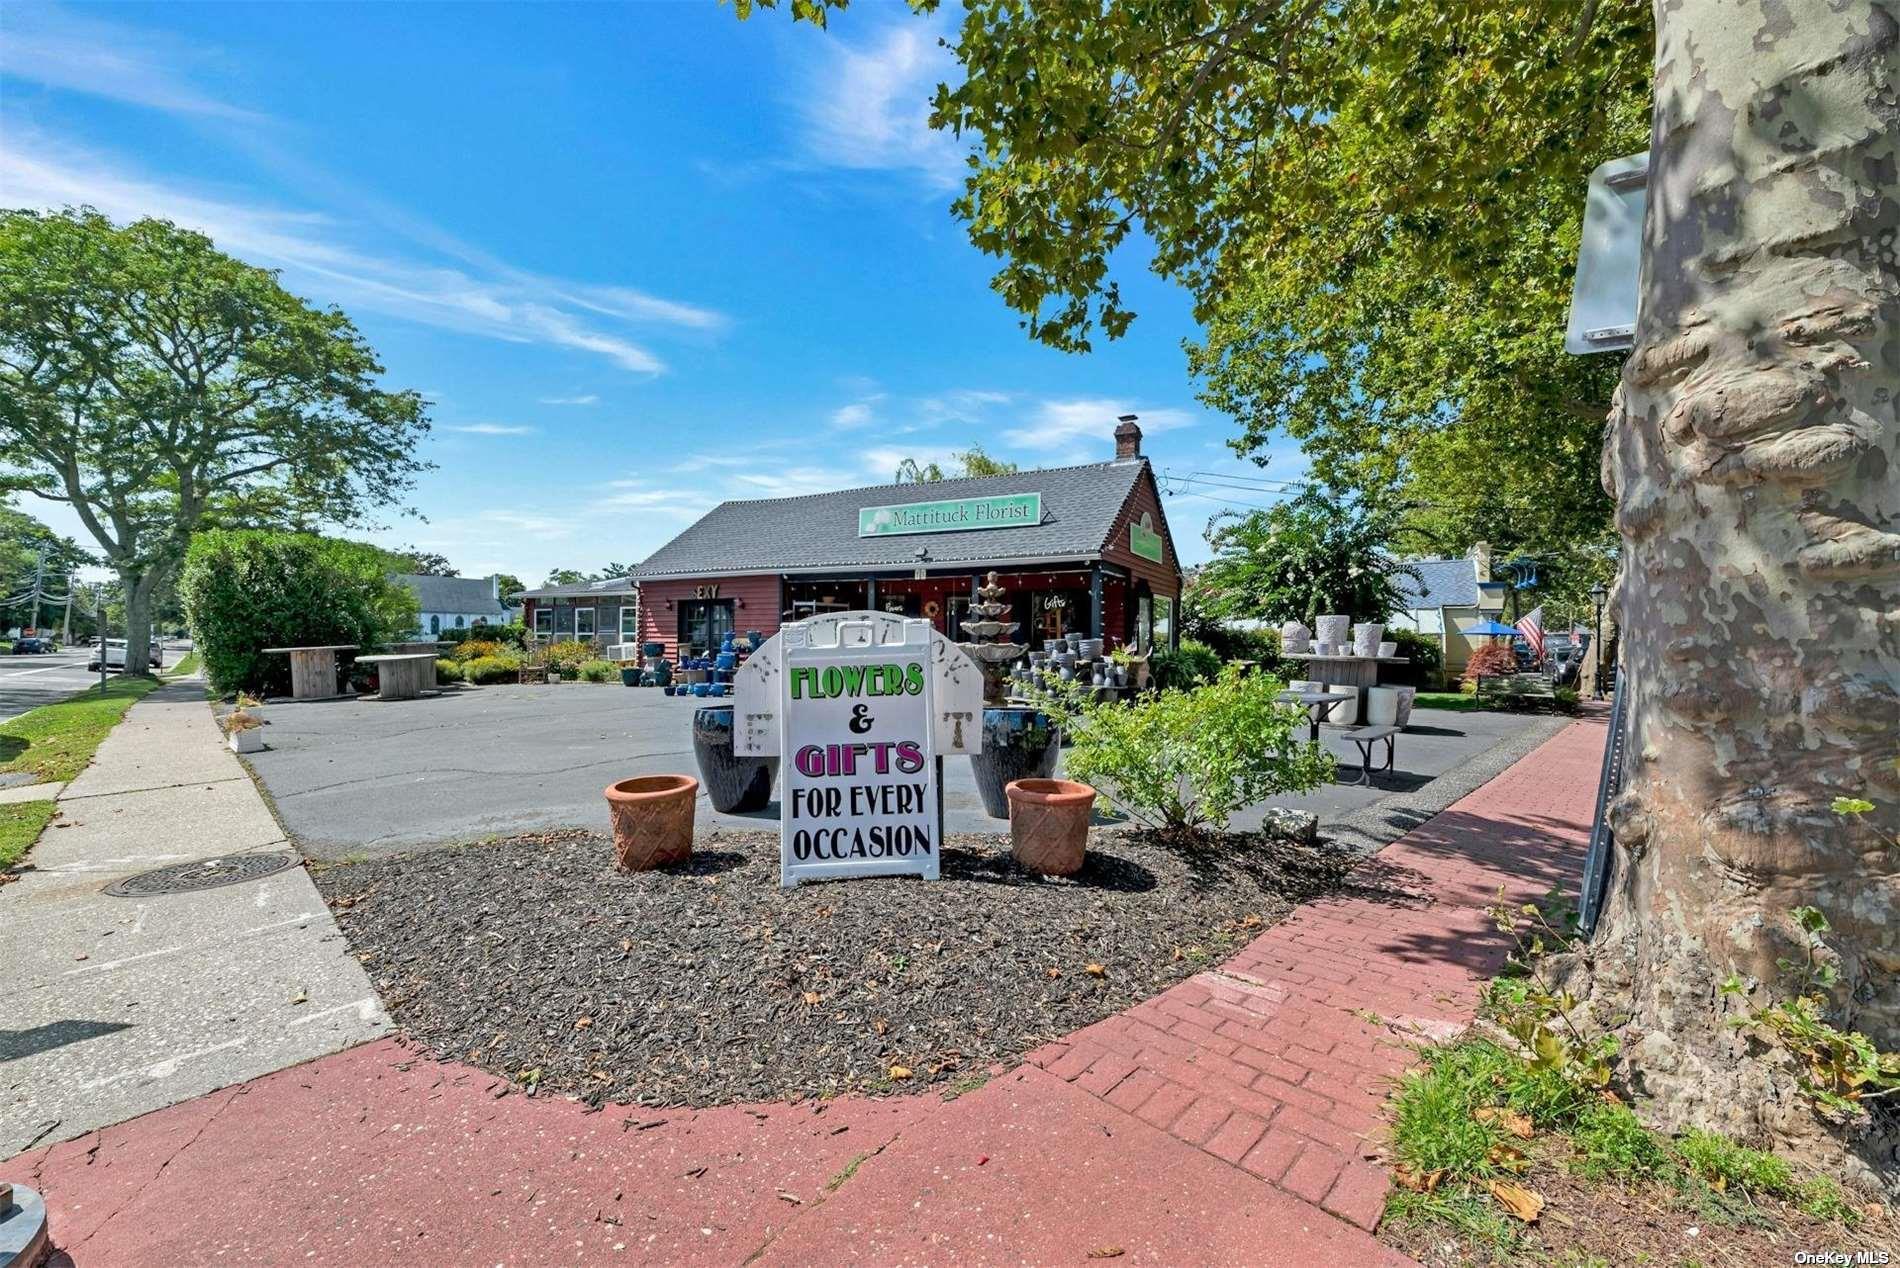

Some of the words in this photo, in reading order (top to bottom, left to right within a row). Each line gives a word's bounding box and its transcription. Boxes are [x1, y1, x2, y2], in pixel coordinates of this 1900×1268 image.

[893, 506, 968, 527] Mattituck
[975, 503, 1029, 520] Florist
[790, 662, 924, 699] FLOWERS
[849, 704, 874, 734] &
[795, 741, 925, 778] GIFTS
[792, 787, 842, 818] FOR
[850, 783, 927, 816] EVERY
[793, 824, 931, 860] OCCASION
